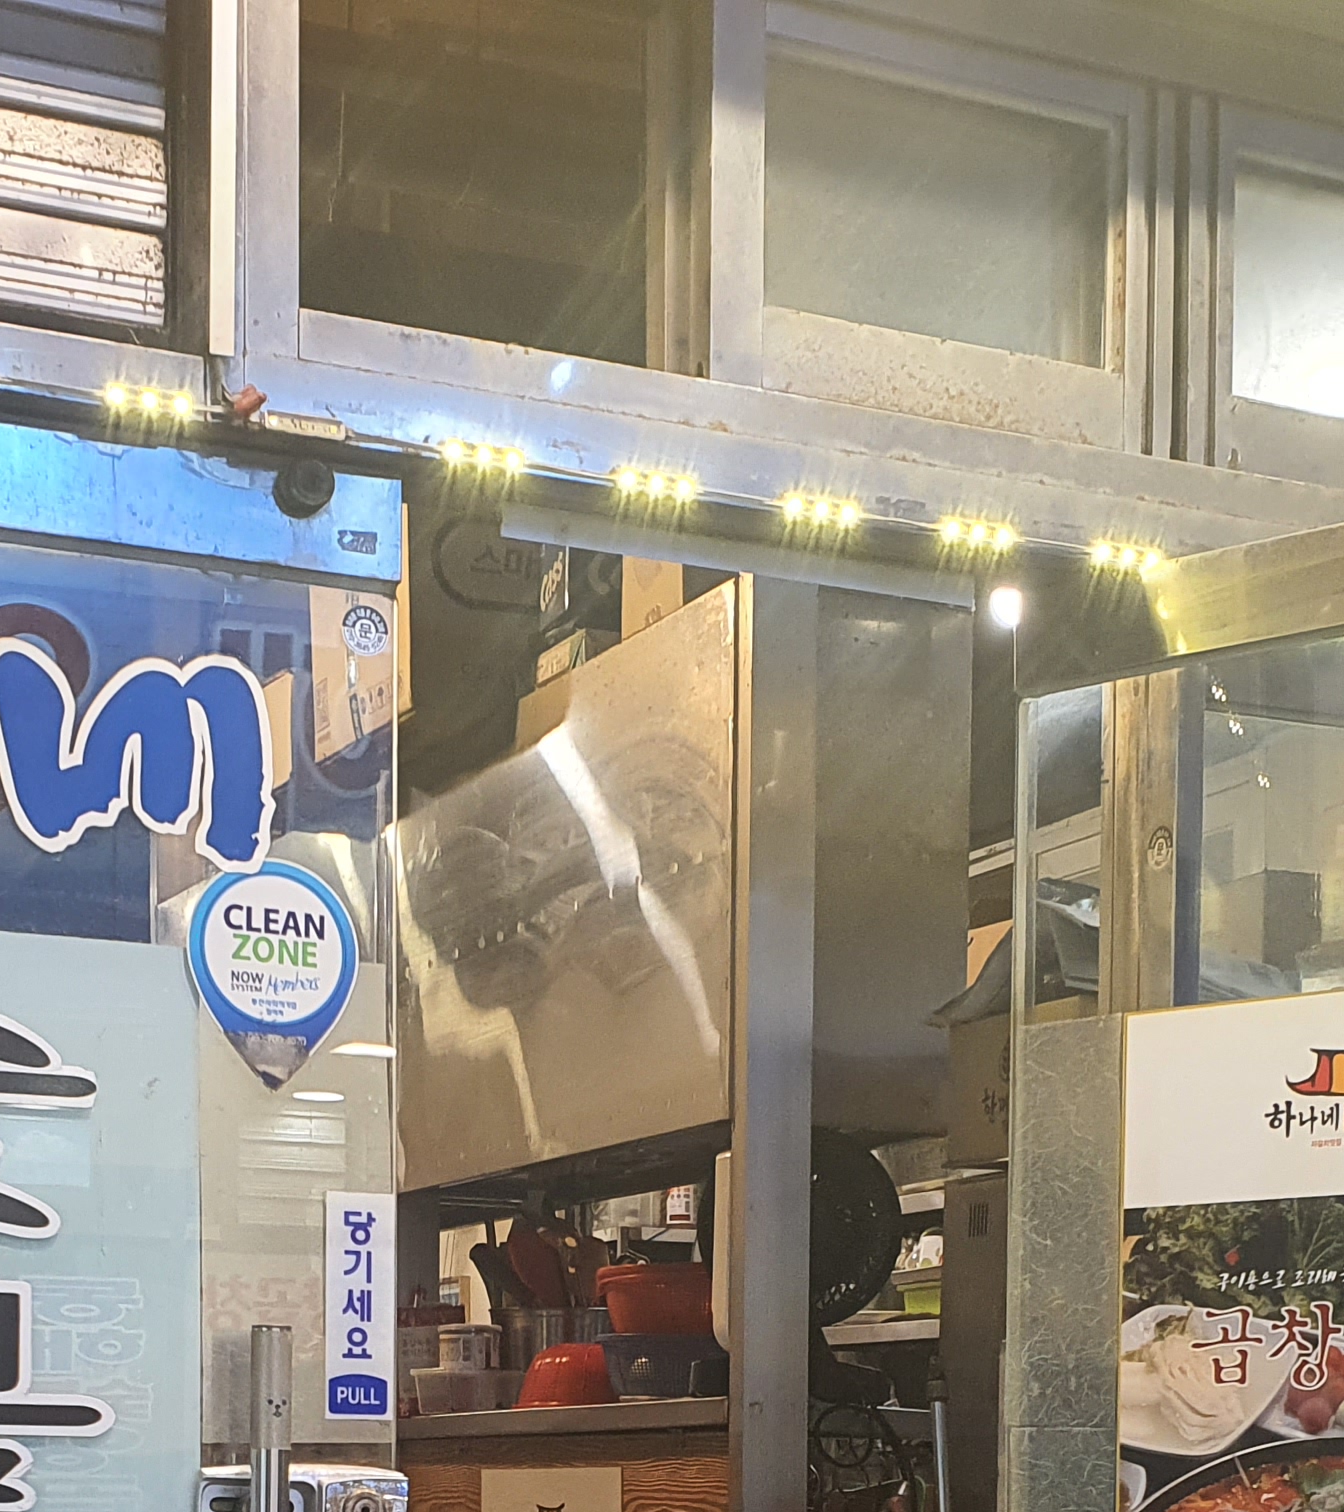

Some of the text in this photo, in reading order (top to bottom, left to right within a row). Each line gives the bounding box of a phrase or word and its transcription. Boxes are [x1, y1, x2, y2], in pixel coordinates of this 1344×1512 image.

[223, 903, 325, 941] CLEAN
[231, 932, 319, 969] ZONE
[231, 969, 264, 984] NOW
[265, 970, 321, 996] Members
[1264, 1100, 1341, 1139] 하나네
[341, 1210, 376, 1360] 당기세요
[336, 1385, 381, 1407] PULL
